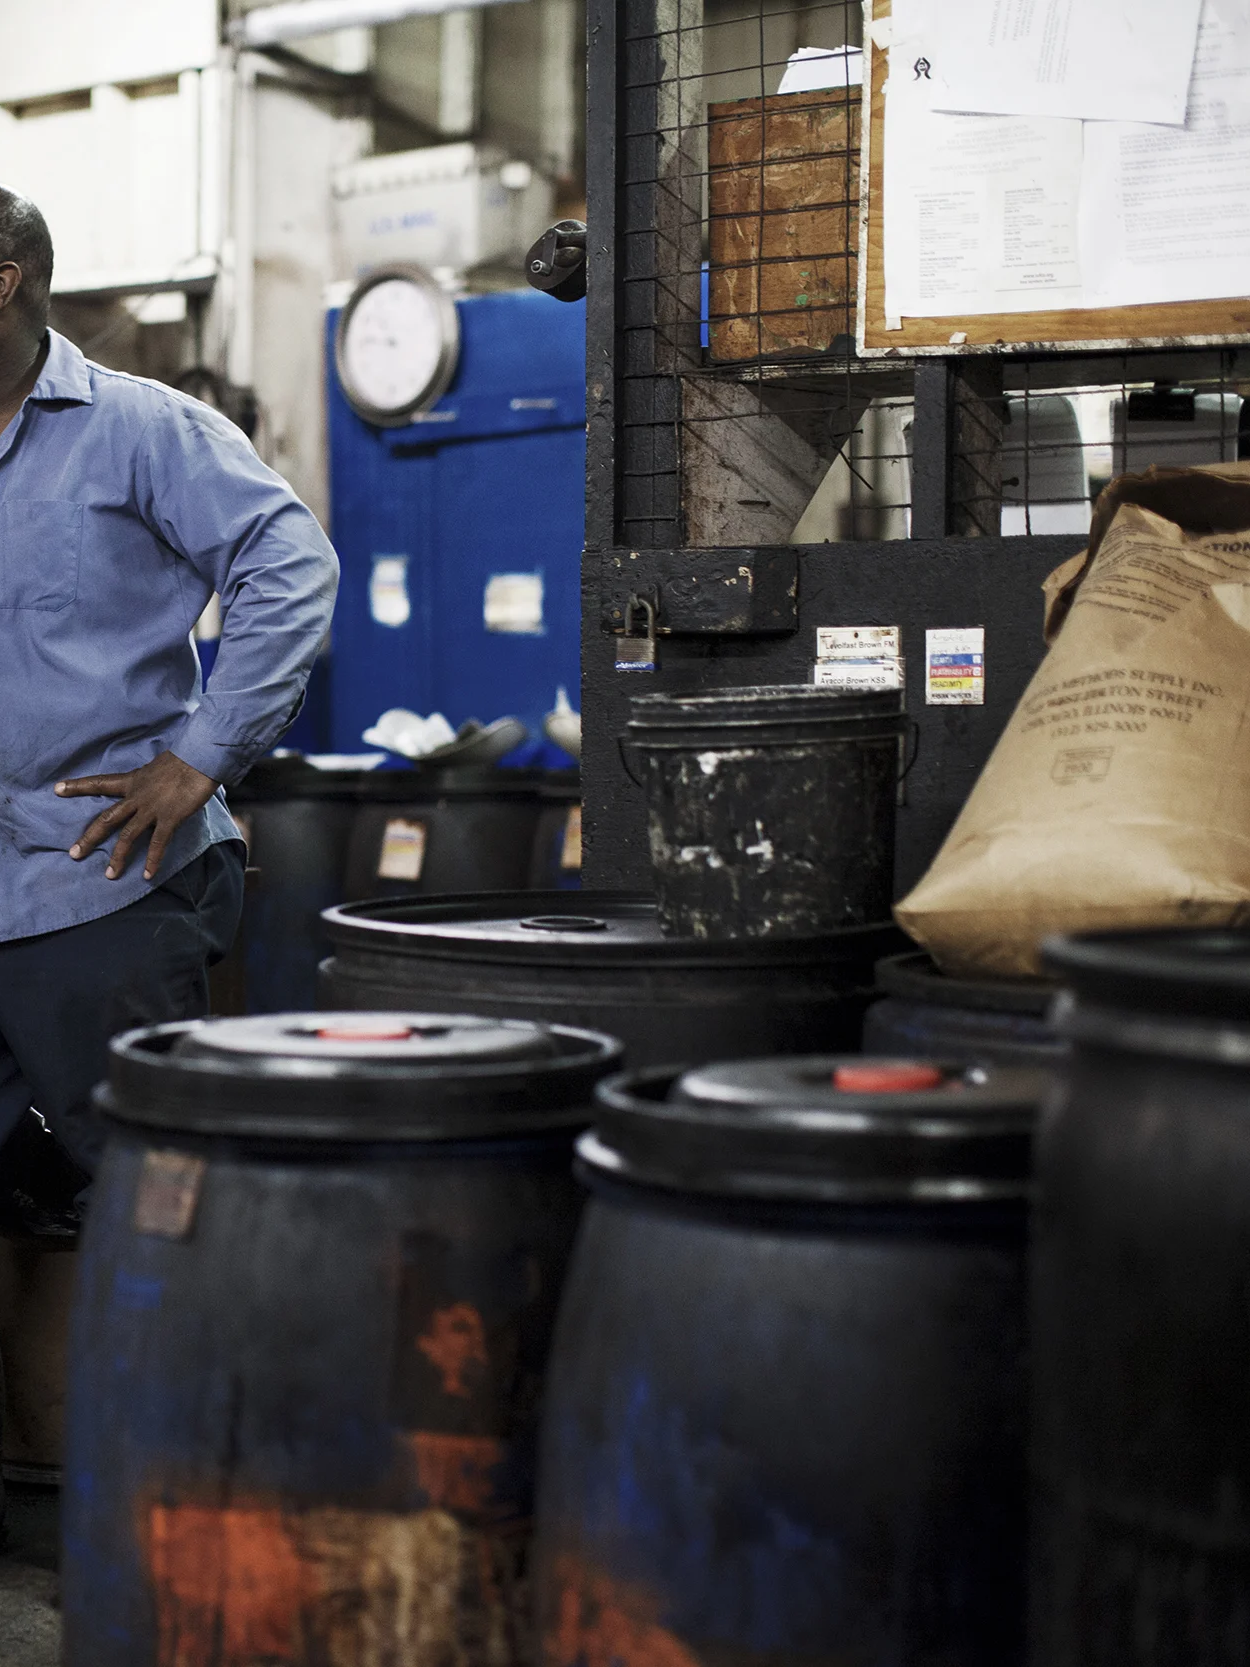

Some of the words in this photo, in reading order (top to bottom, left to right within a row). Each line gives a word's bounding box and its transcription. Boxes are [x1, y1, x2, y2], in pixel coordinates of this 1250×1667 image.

[858, 641, 882, 649] Brown
[846, 677, 868, 685] Brown
[1131, 669, 1185, 689] SUPPLY
[1146, 688, 1207, 709] STREET
